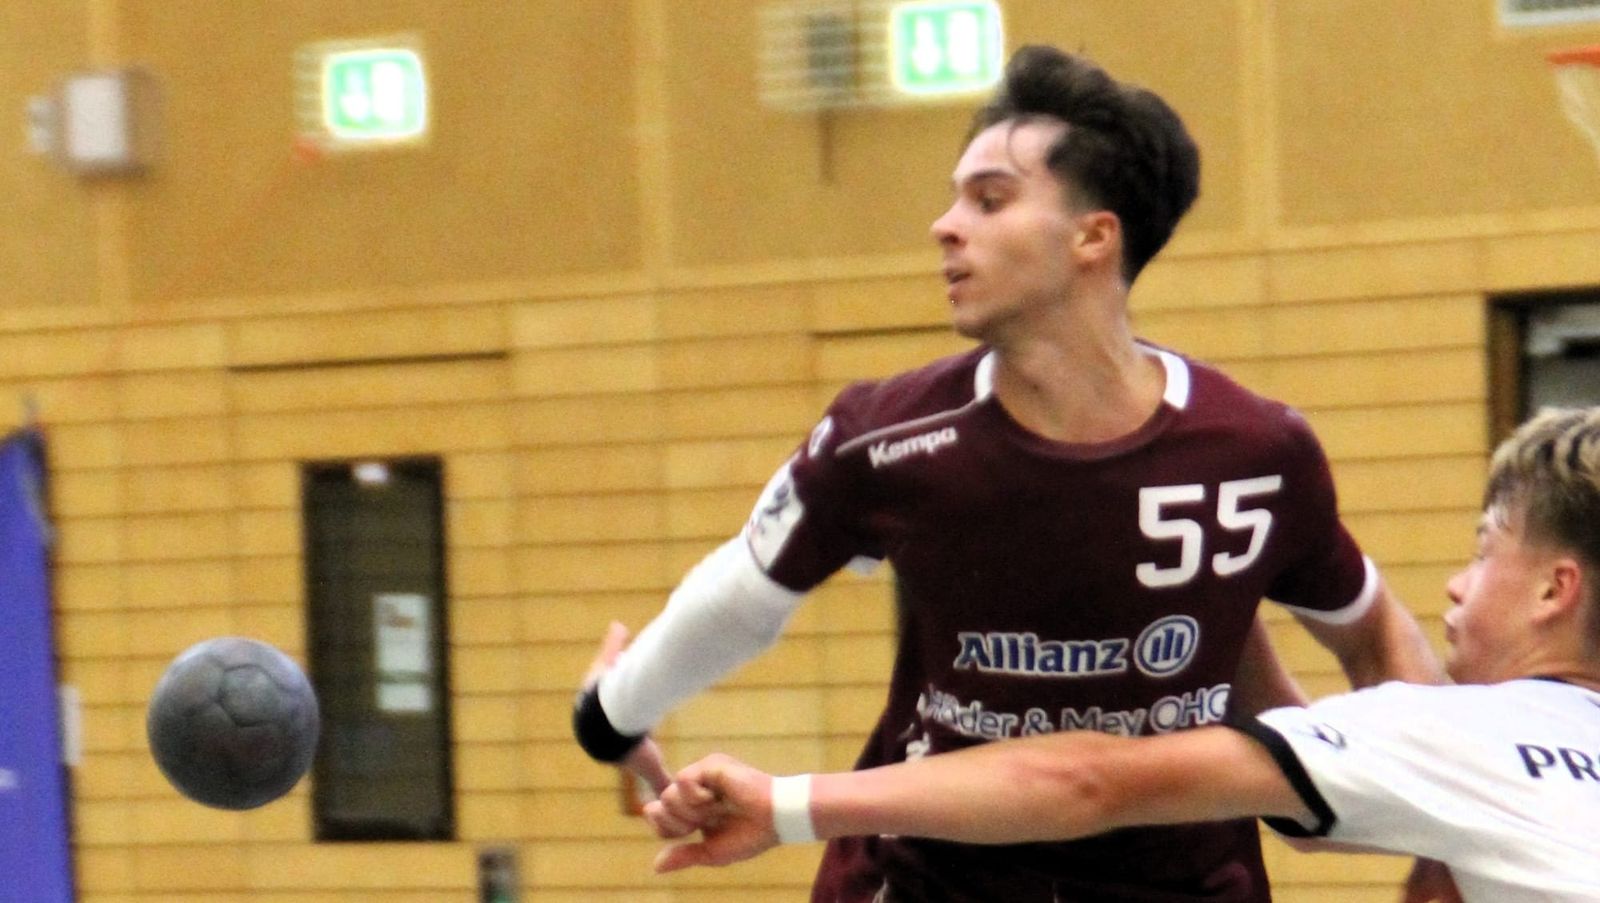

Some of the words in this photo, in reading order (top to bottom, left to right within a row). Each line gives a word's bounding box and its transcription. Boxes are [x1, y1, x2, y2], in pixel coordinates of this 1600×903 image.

[867, 426, 958, 469] Kempa
[1135, 474, 1283, 589] 55
[953, 632, 1129, 677] Allianz
[1514, 743, 1600, 782] PR
